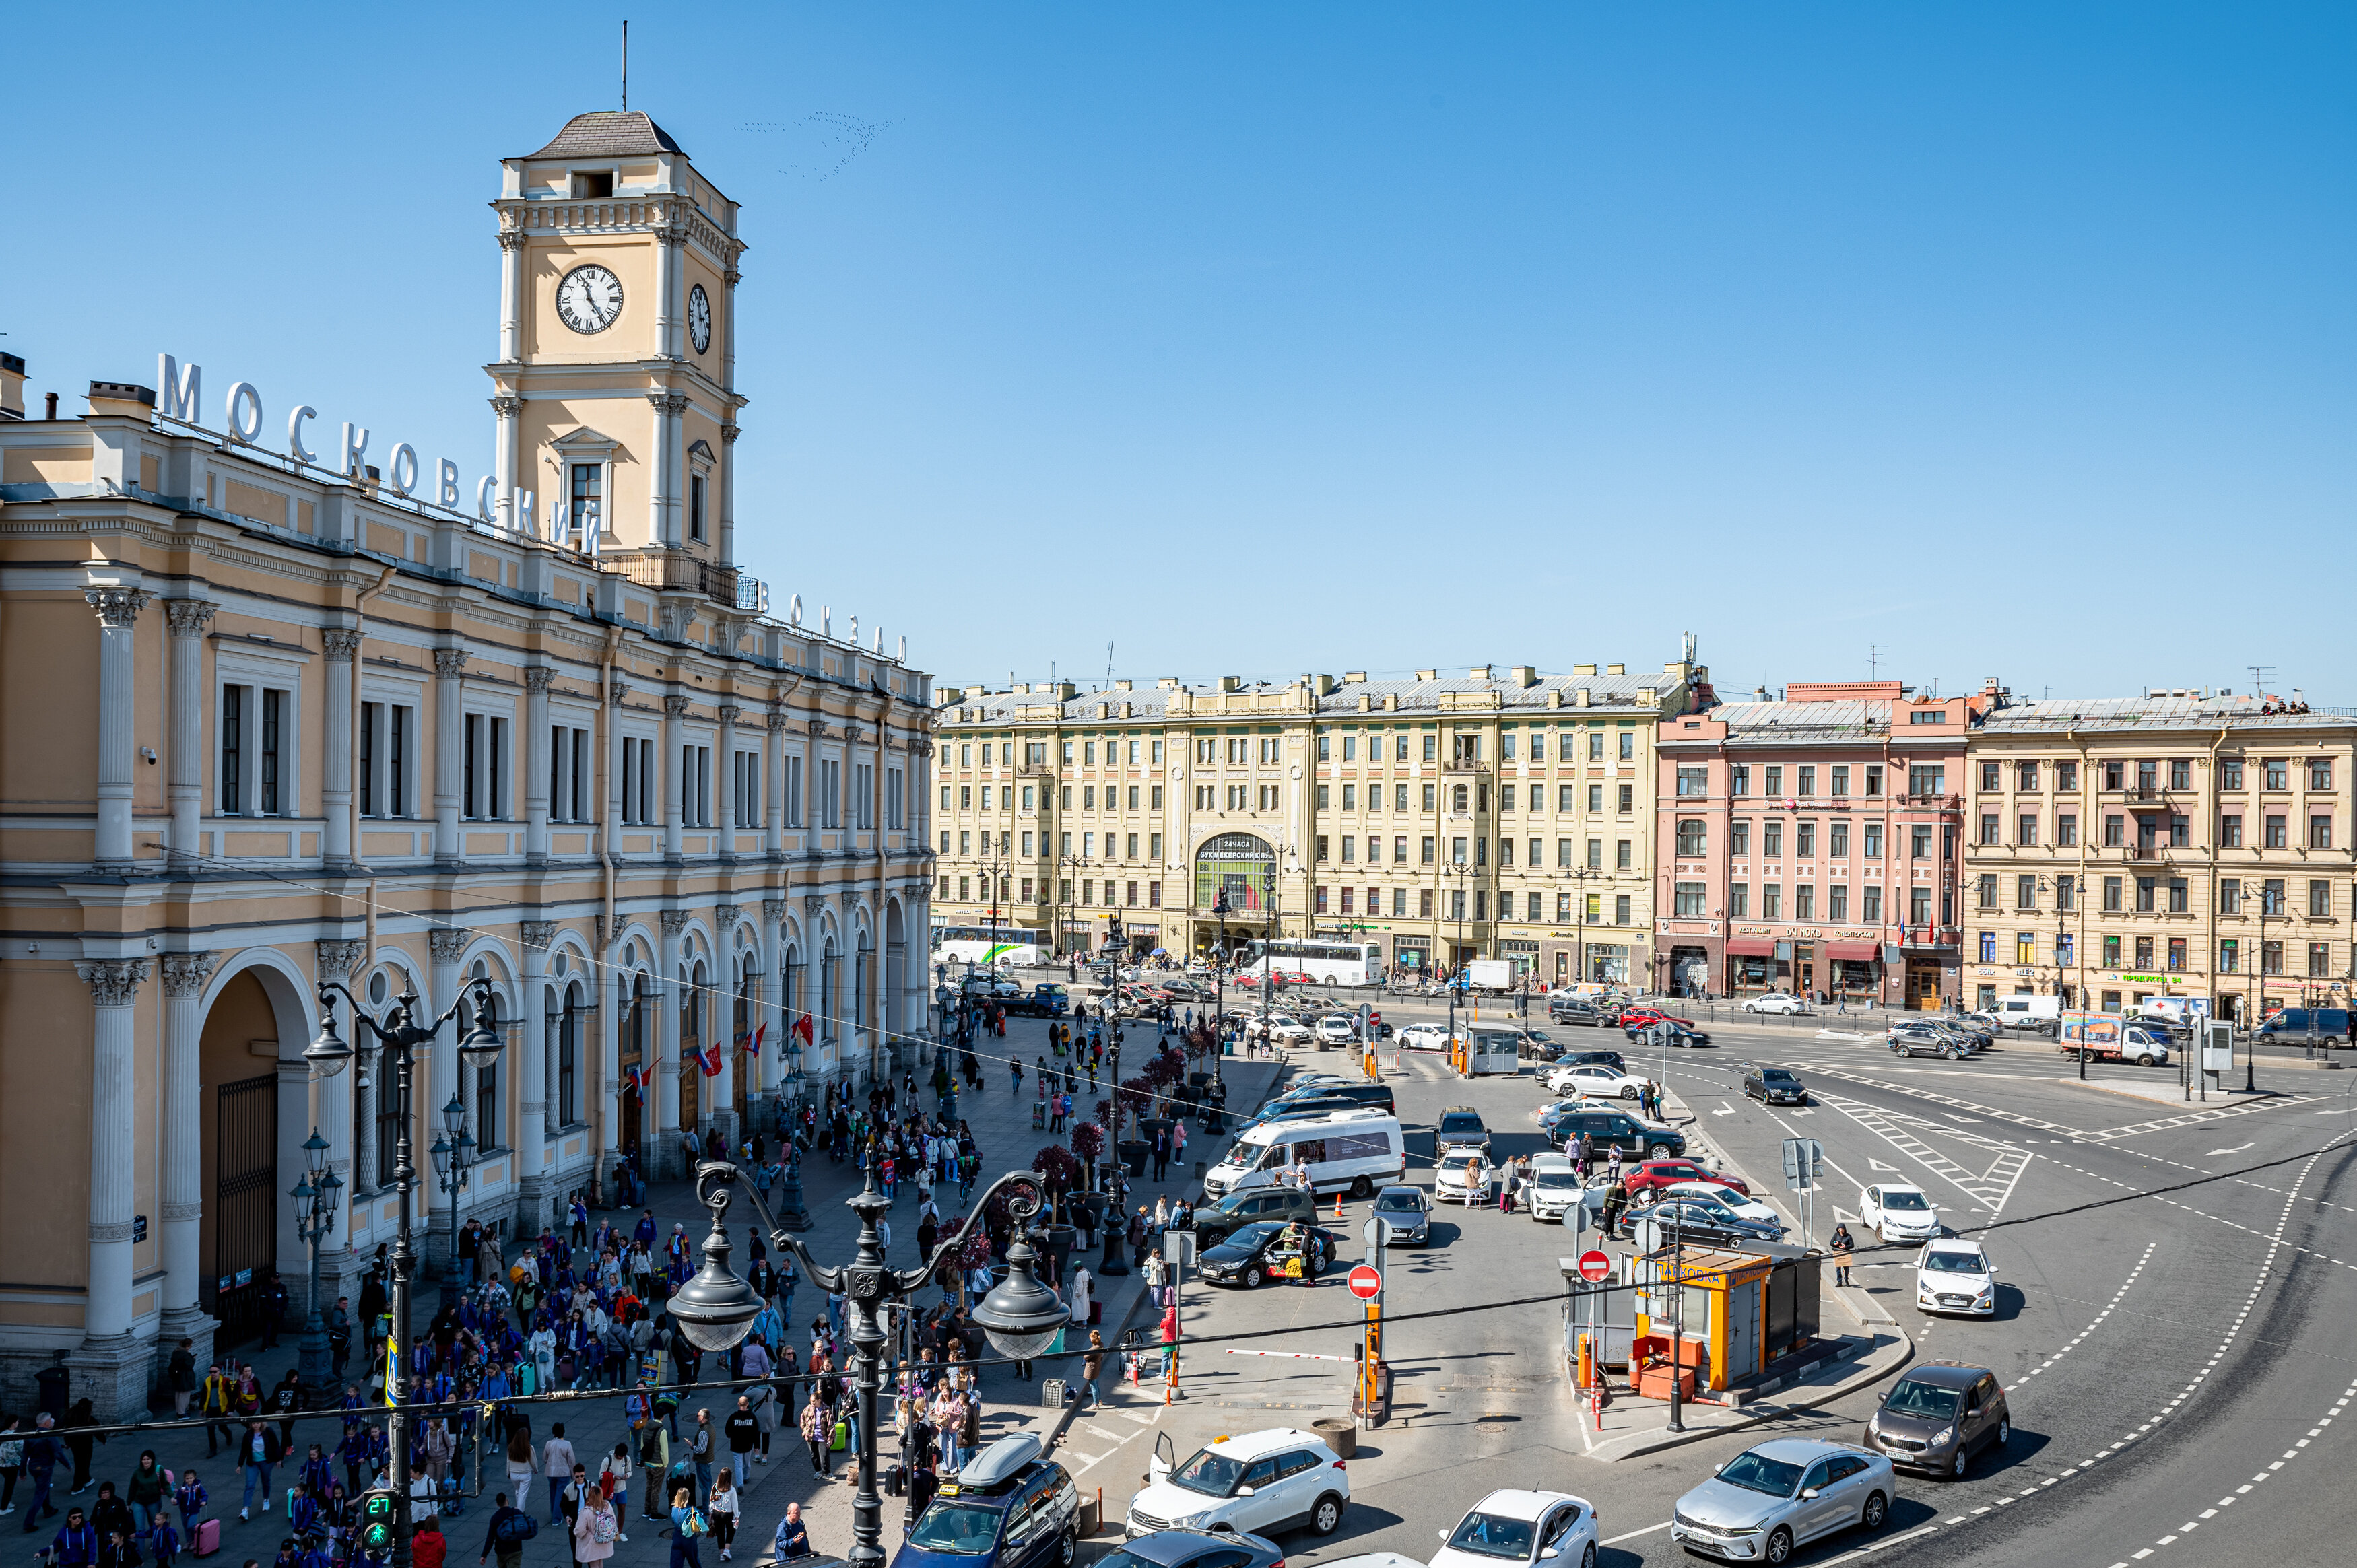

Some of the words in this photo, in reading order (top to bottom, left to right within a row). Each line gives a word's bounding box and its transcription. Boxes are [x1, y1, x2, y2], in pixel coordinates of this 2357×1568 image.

[585, 270, 595, 279] XII
[158, 353, 601, 557] МОСКОВСКИЙ
[758, 581, 906, 662] ВОКЗАЛ
[1200, 852, 1254, 860] БУКМЕКЕРСКИЙ
[1738, 926, 1771, 935] RESTAURANT
[1786, 927, 1797, 936] DU
[1800, 928, 1822, 938] NORD
[1834, 930, 1875, 939] КОНДИТЕРСКАЯ
[2107, 936, 2118, 945] 24
[2224, 940, 2236, 948] 24
[2016, 967, 2034, 976] TELE2
[2123, 975, 2167, 983] ПРОДУКТЫ
[1657, 1264, 1720, 1285] ПАРКОВКА
[733, 1419, 754, 1427] PUMA
[369, 1499, 389, 1513] 27
